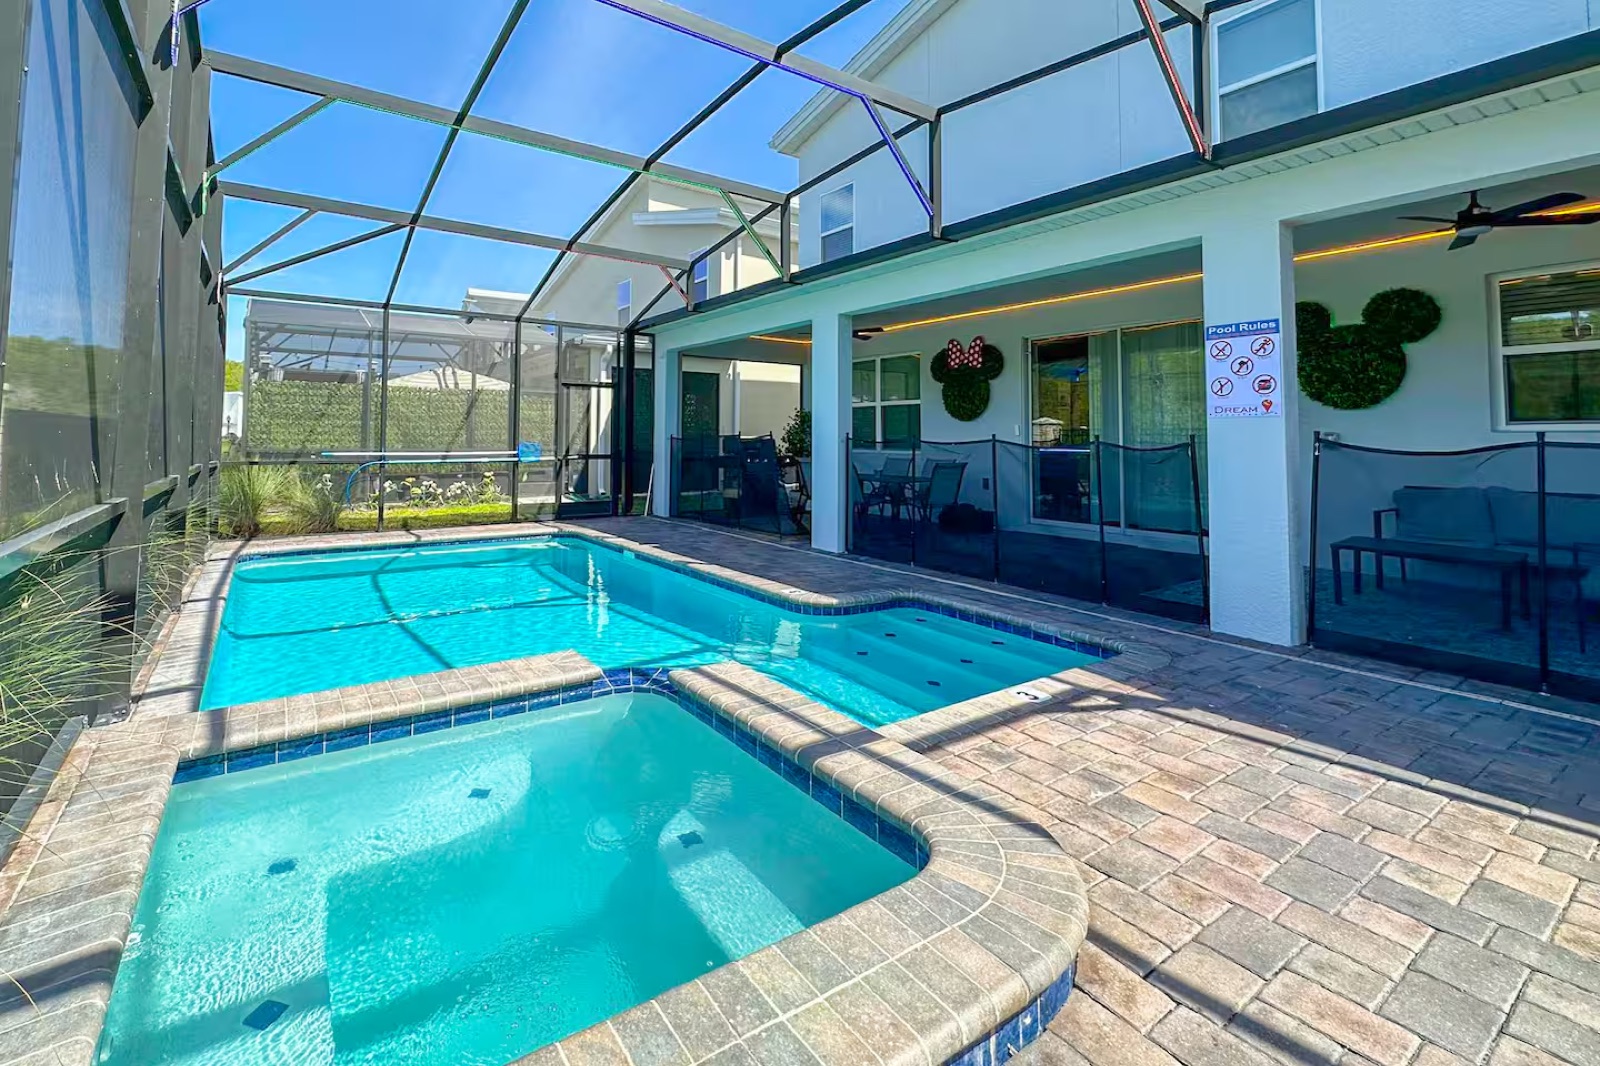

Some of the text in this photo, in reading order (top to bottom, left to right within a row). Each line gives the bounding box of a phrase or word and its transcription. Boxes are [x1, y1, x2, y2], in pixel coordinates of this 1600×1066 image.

[1208, 321, 1276, 335] Pool Rules
[1214, 405, 1258, 414] DREAM
